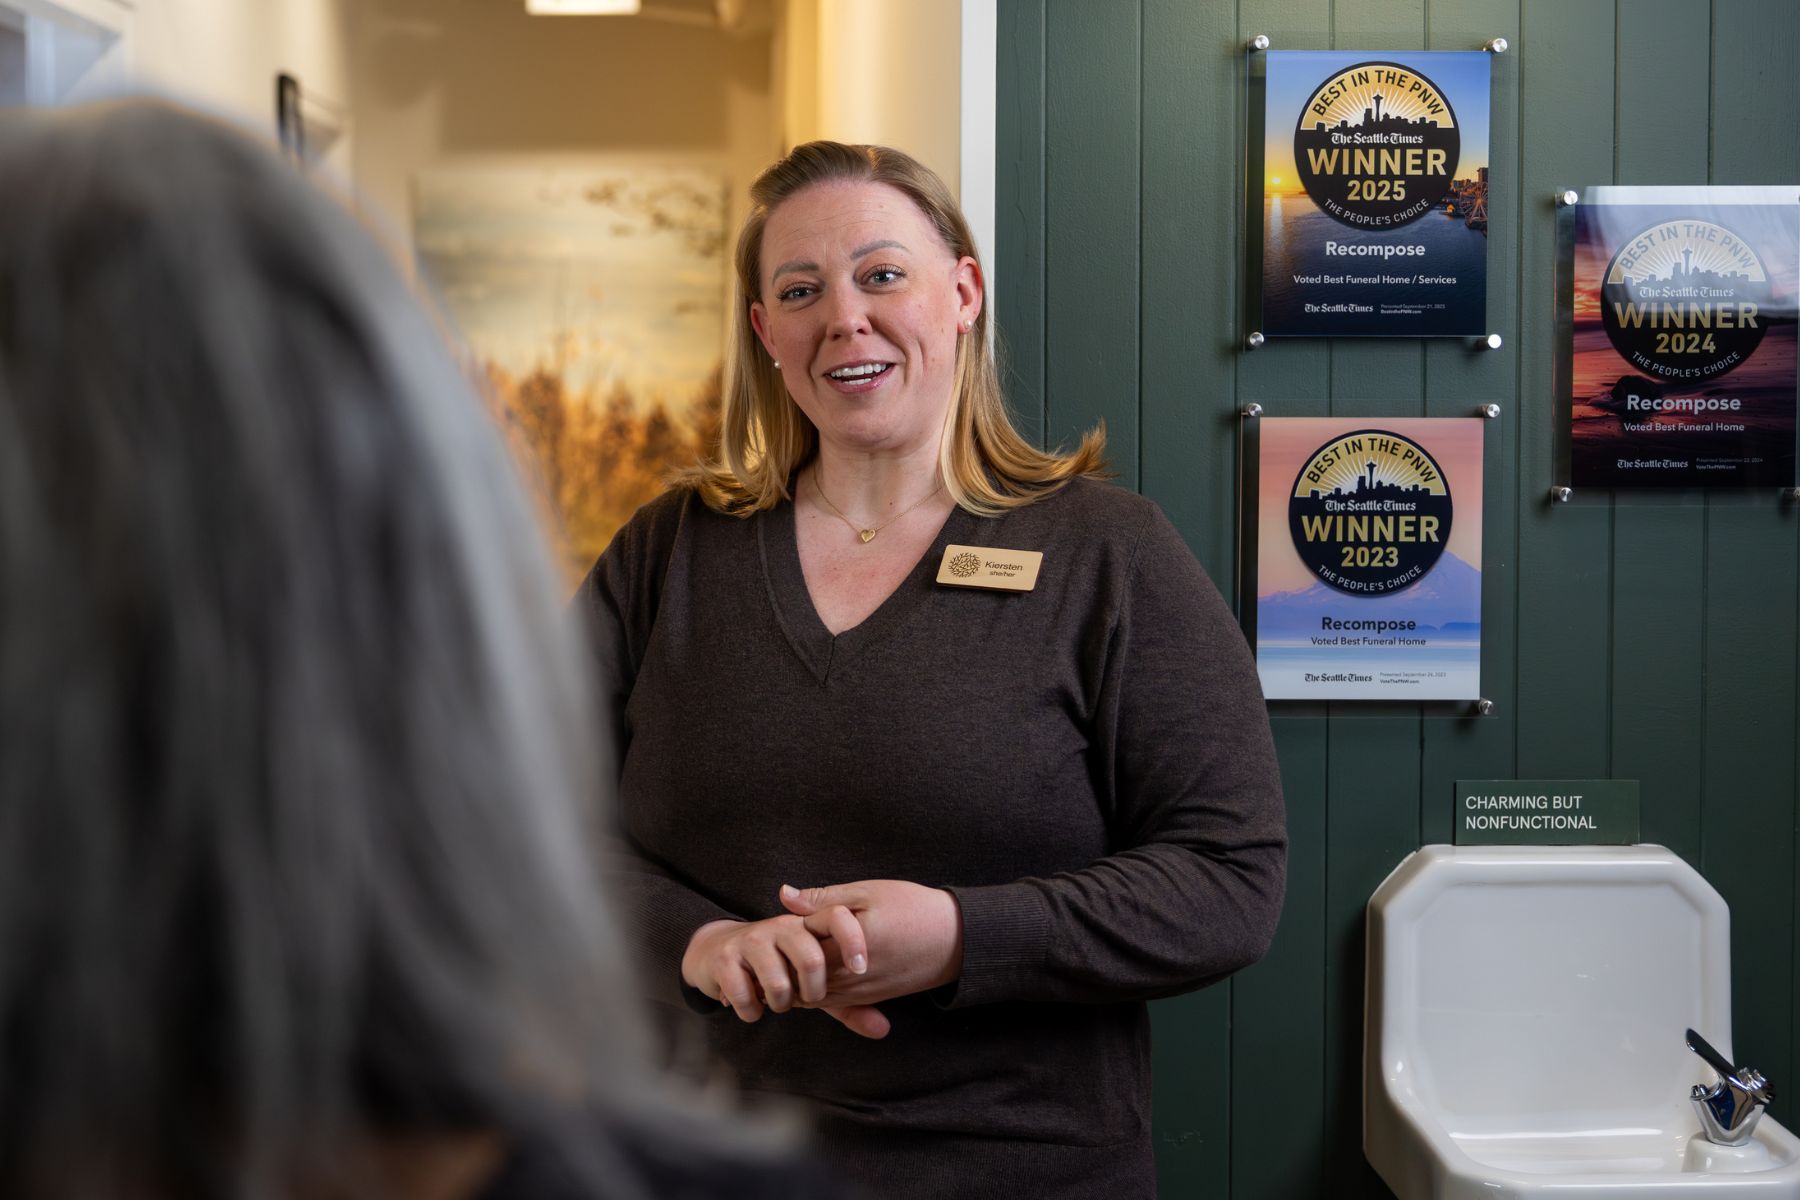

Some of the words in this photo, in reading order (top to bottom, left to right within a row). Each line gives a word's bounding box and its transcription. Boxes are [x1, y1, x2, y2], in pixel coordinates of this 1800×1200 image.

[1312, 78, 1348, 116] BEST
[1351, 71, 1370, 88] IN
[1374, 70, 1408, 88] THE
[1409, 80, 1444, 116] PNW
[1332, 132, 1352, 145] The
[1353, 132, 1389, 144] Seattle
[1390, 132, 1424, 144] Times
[1307, 148, 1447, 176] WINNER
[1347, 180, 1406, 200] 2025
[1324, 198, 1341, 215] THE
[1343, 210, 1391, 224] PEOPLE'S
[1394, 198, 1429, 222] CHOICE
[1325, 240, 1426, 260] Recompose
[1620, 234, 1656, 270] BEST
[1659, 224, 1679, 242] IN
[1684, 224, 1718, 242] THE
[1719, 234, 1755, 268] PNW
[1294, 275, 1322, 284] Voted
[1324, 275, 1344, 284] Best
[1346, 274, 1380, 284] Funeral
[1382, 275, 1410, 284] Home
[1418, 275, 1457, 284] Services
[1639, 286, 1660, 298] The
[1662, 286, 1698, 298] Seattle
[1698, 286, 1734, 298] Times
[1304, 304, 1320, 314] The
[1321, 303, 1347, 313] Seattle
[1348, 304, 1374, 313] Times
[1614, 302, 1759, 329] WINNER
[1656, 333, 1716, 354] 2024
[1632, 351, 1650, 368] THE
[1651, 363, 1700, 378] PEOPLE'S
[1704, 351, 1740, 375] CHOICE
[1626, 394, 1742, 415] Recompose
[1624, 422, 1652, 432] Voted
[1656, 423, 1676, 432] Best
[1678, 422, 1713, 432] Funeral
[1716, 423, 1744, 432] Home
[1307, 446, 1342, 484] BEST
[1344, 438, 1363, 455] IN
[1368, 438, 1402, 456] THE
[1402, 448, 1436, 484] PNW
[1617, 459, 1634, 469] The
[1634, 459, 1662, 468] Seattle
[1662, 459, 1689, 468] Times
[1325, 500, 1346, 512] The
[1347, 499, 1382, 511] Seattle
[1383, 500, 1416, 512] Times
[1301, 515, 1440, 543] WINNER
[985, 561, 1023, 571] Kiersten
[1341, 546, 1399, 568] 2023
[1318, 564, 1335, 582] THE
[1337, 576, 1384, 591] PEOPLE'S
[1386, 564, 1422, 589] CHOICE
[1321, 616, 1416, 634] Recompose
[1311, 637, 1338, 646] Voted
[1340, 637, 1360, 646] Best
[1362, 637, 1396, 646] Funeral
[1398, 637, 1426, 646] Home
[1305, 673, 1321, 683] The
[1321, 673, 1347, 682] Seattle
[1347, 673, 1373, 682] Times
[1466, 796, 1548, 810] CHARMING
[1553, 796, 1582, 809] BUT
[1466, 816, 1597, 829] NONFUNCTIONAL
